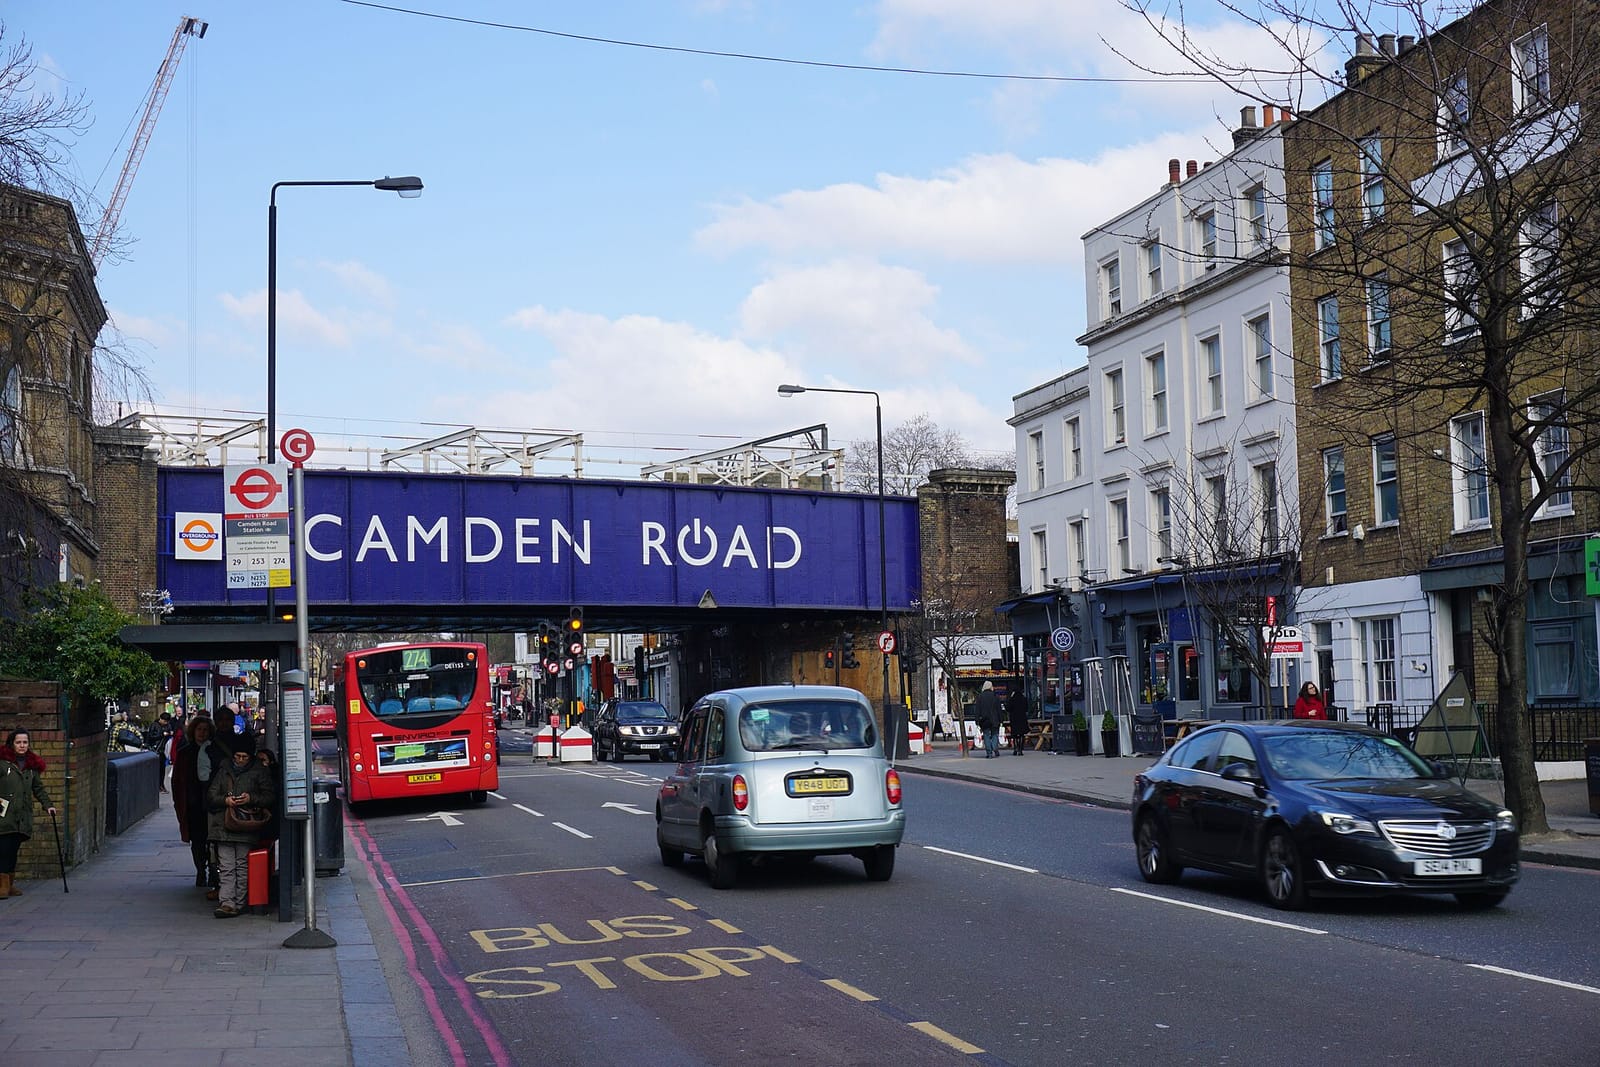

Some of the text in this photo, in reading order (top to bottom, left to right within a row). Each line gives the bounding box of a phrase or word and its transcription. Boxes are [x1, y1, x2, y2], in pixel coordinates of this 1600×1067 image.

[285, 433, 307, 458] G
[304, 514, 802, 569] CAMDEN ROAD
[404, 650, 428, 668] 274
[796, 780, 823, 790] Y848
[469, 916, 691, 952] BUS
[465, 947, 766, 998] STOP
